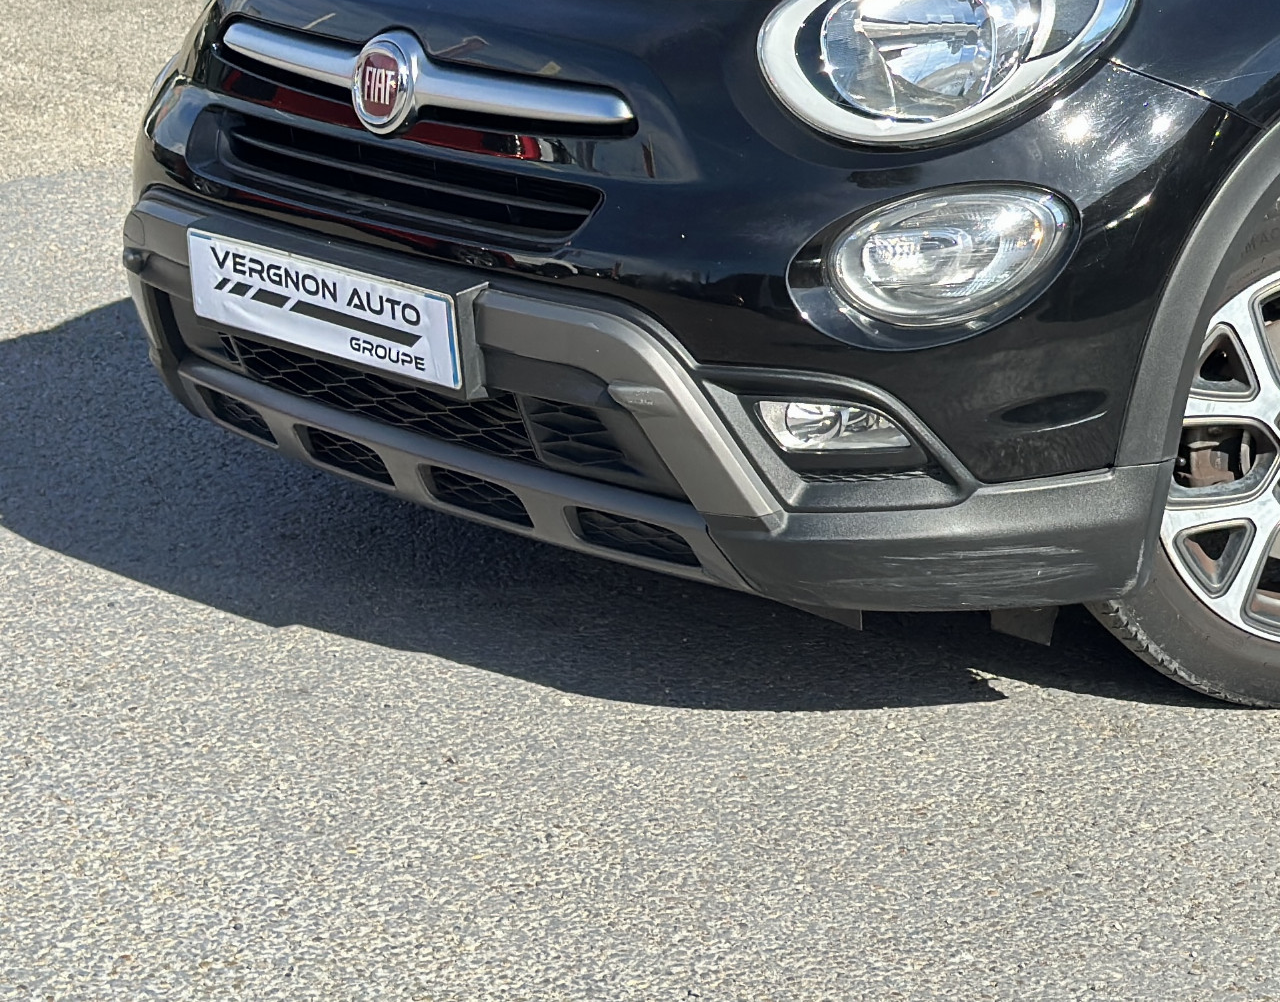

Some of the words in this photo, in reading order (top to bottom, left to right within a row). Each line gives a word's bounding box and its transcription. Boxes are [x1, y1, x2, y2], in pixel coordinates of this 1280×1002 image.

[364, 65, 396, 106] FIAT
[209, 246, 338, 303] VERGNON
[346, 287, 421, 327] AUTO
[349, 336, 426, 372] GROUPE
